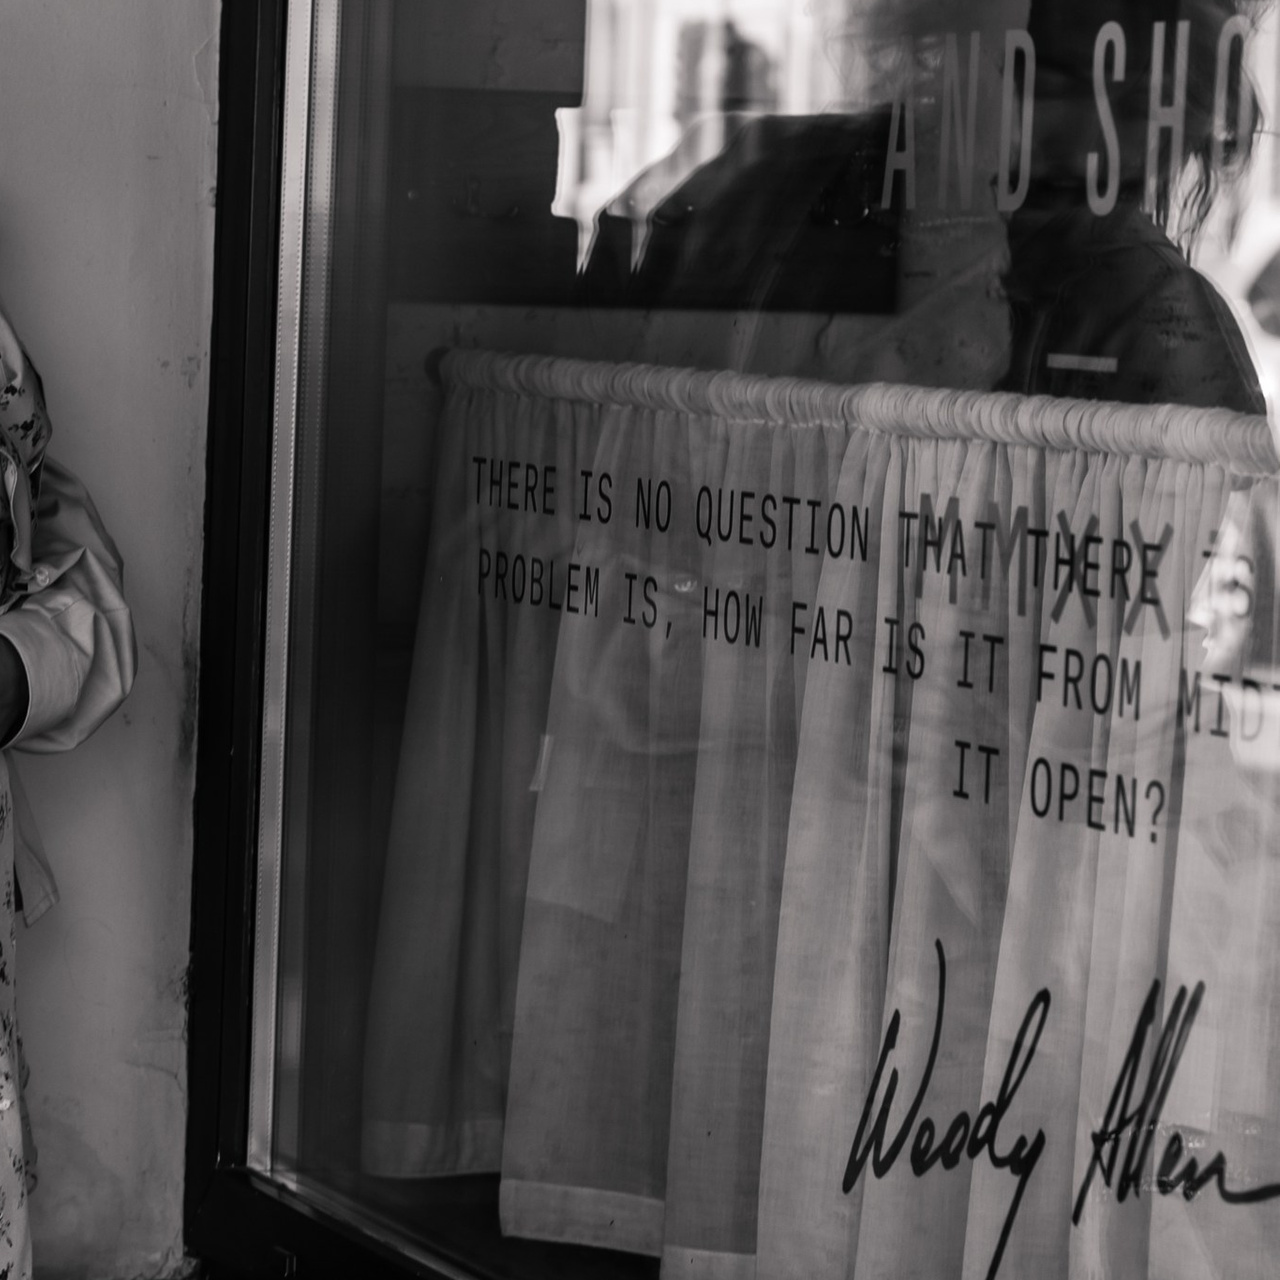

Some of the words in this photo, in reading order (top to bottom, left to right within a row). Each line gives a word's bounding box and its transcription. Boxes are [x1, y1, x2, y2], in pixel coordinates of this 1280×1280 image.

[880, 28, 1036, 212] AND
[472, 456, 557, 516] THERE
[579, 470, 613, 524] IS
[635, 477, 672, 533] NO
[695, 485, 870, 562] QUESTION
[899, 511, 996, 580] THAT
[1027, 527, 1163, 607] THERE
[477, 547, 600, 618] PROBLEM
[623, 572, 673, 640] IS,
[702, 586, 763, 649] HOW
[791, 601, 853, 666] FAR
[882, 617, 926, 680] IS
[957, 630, 1004, 693] IT
[1036, 643, 1142, 721] FROM
[1178, 668, 1280, 743] MID
[953, 739, 1000, 805] IT
[1030, 757, 1165, 844] OPEN?
[1072, 978, 1280, 1227] Allen
